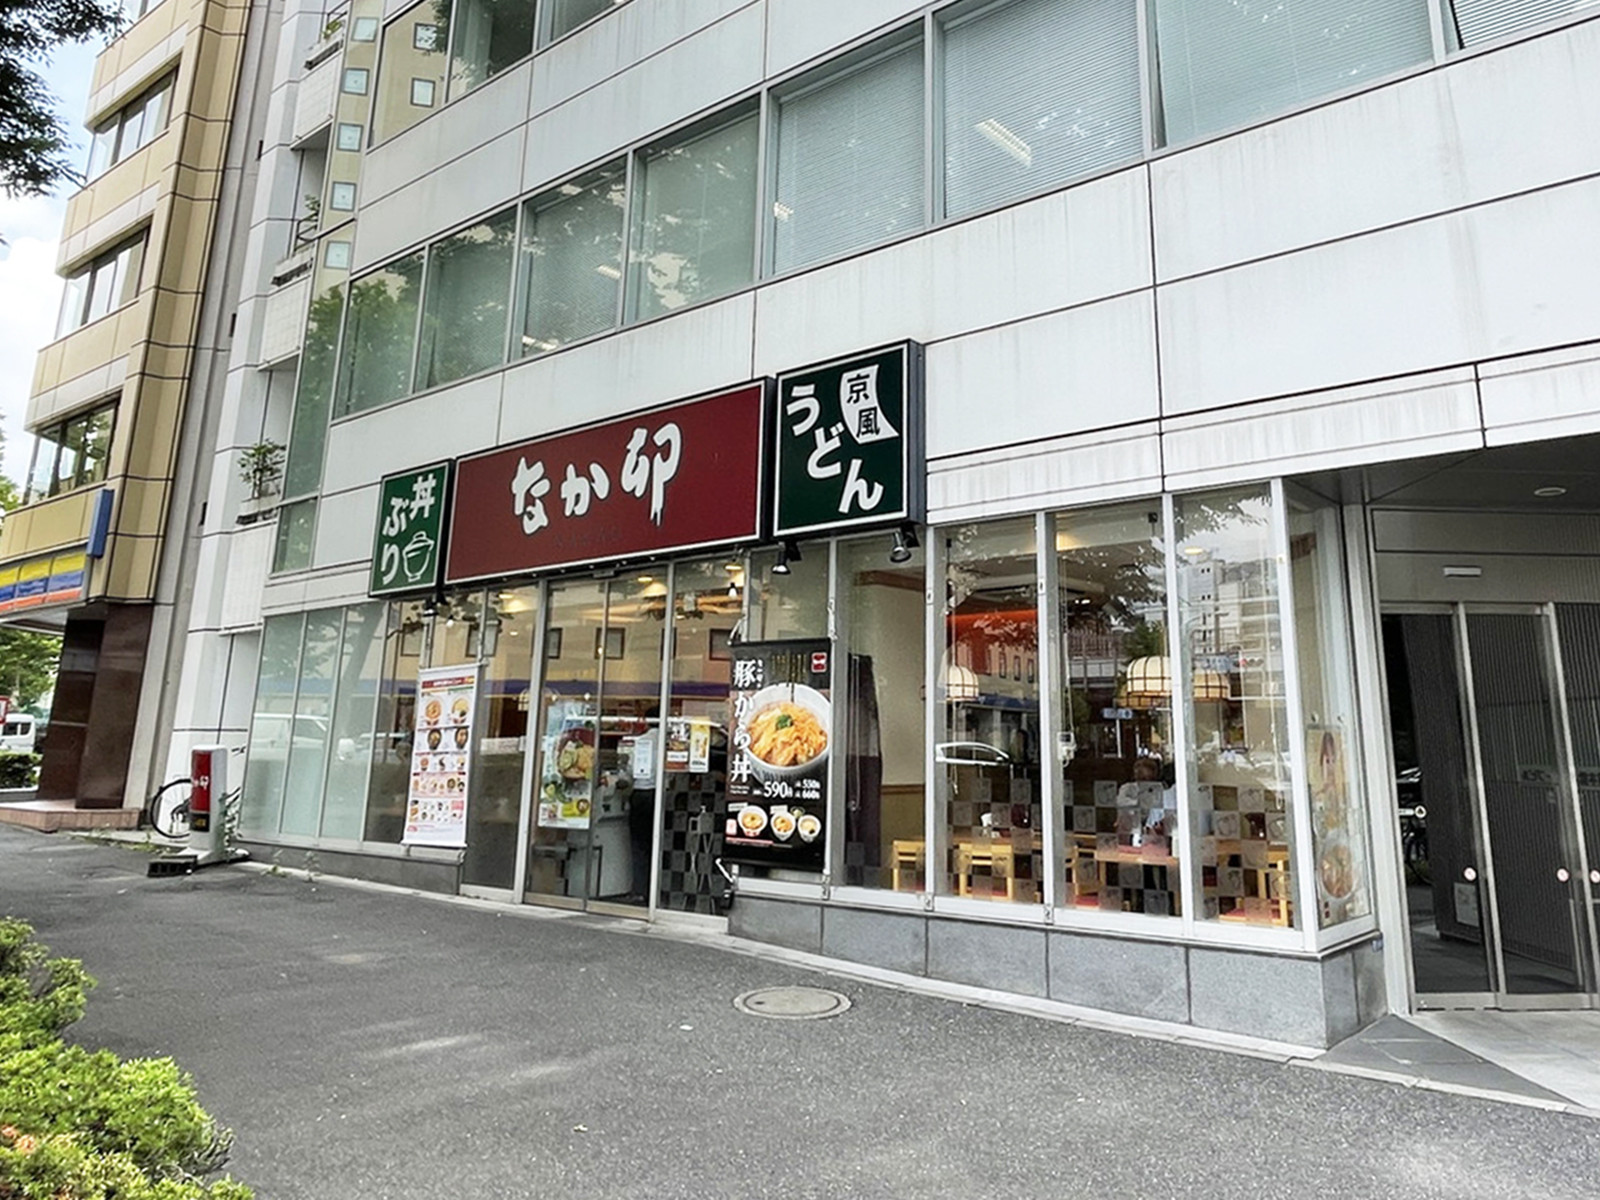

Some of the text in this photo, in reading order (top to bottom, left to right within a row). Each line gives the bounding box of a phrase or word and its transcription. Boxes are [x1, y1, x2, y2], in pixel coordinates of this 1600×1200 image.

[785, 384, 884, 514] うどん
[845, 372, 881, 436] 京風
[511, 422, 682, 535] なか卯
